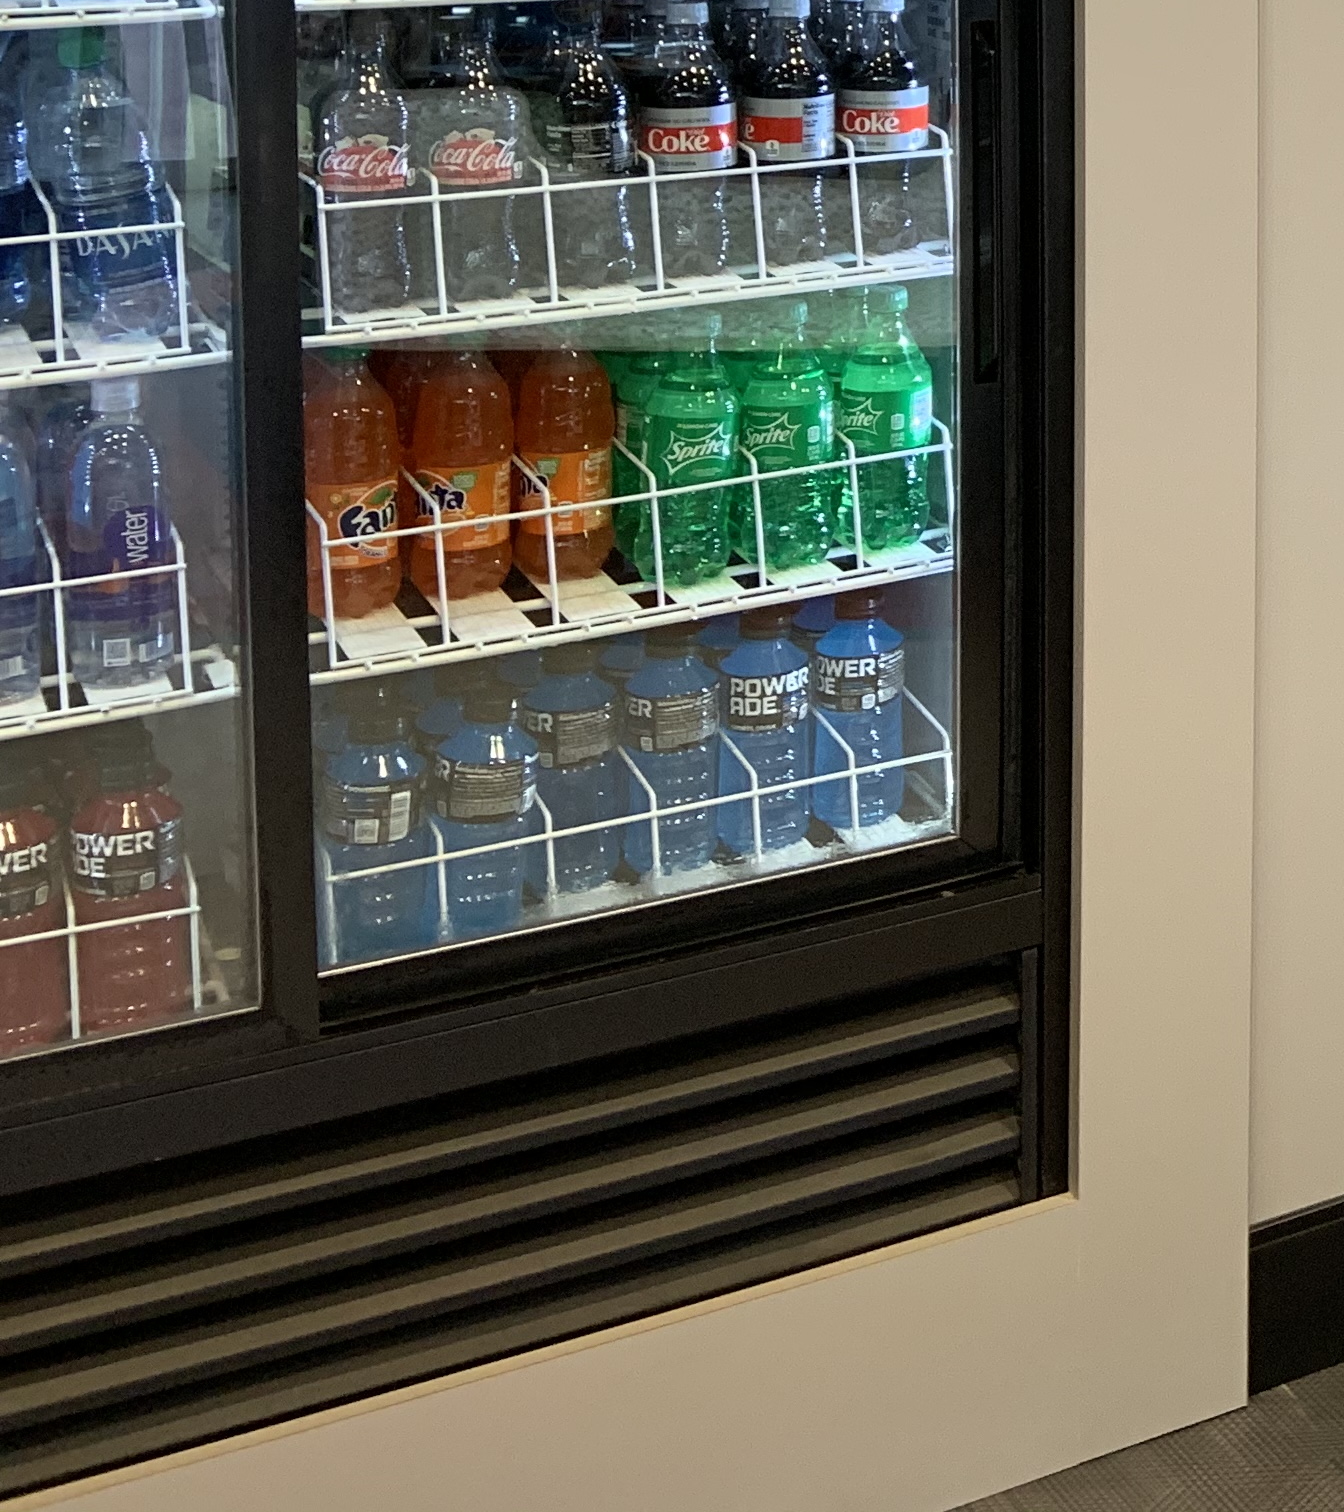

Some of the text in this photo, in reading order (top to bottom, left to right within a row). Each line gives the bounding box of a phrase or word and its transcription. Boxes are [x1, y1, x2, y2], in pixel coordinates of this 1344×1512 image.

[842, 109, 901, 134] Coke
[647, 128, 711, 153] Coke
[317, 143, 411, 179] Coca-Cola
[428, 137, 518, 173] Coca-Cola
[745, 425, 791, 446] Sprite
[667, 436, 730, 463] Sprite
[120, 510, 149, 564] water
[730, 666, 809, 698] POWER
[730, 695, 778, 717] ADE
[75, 857, 107, 879] DE
